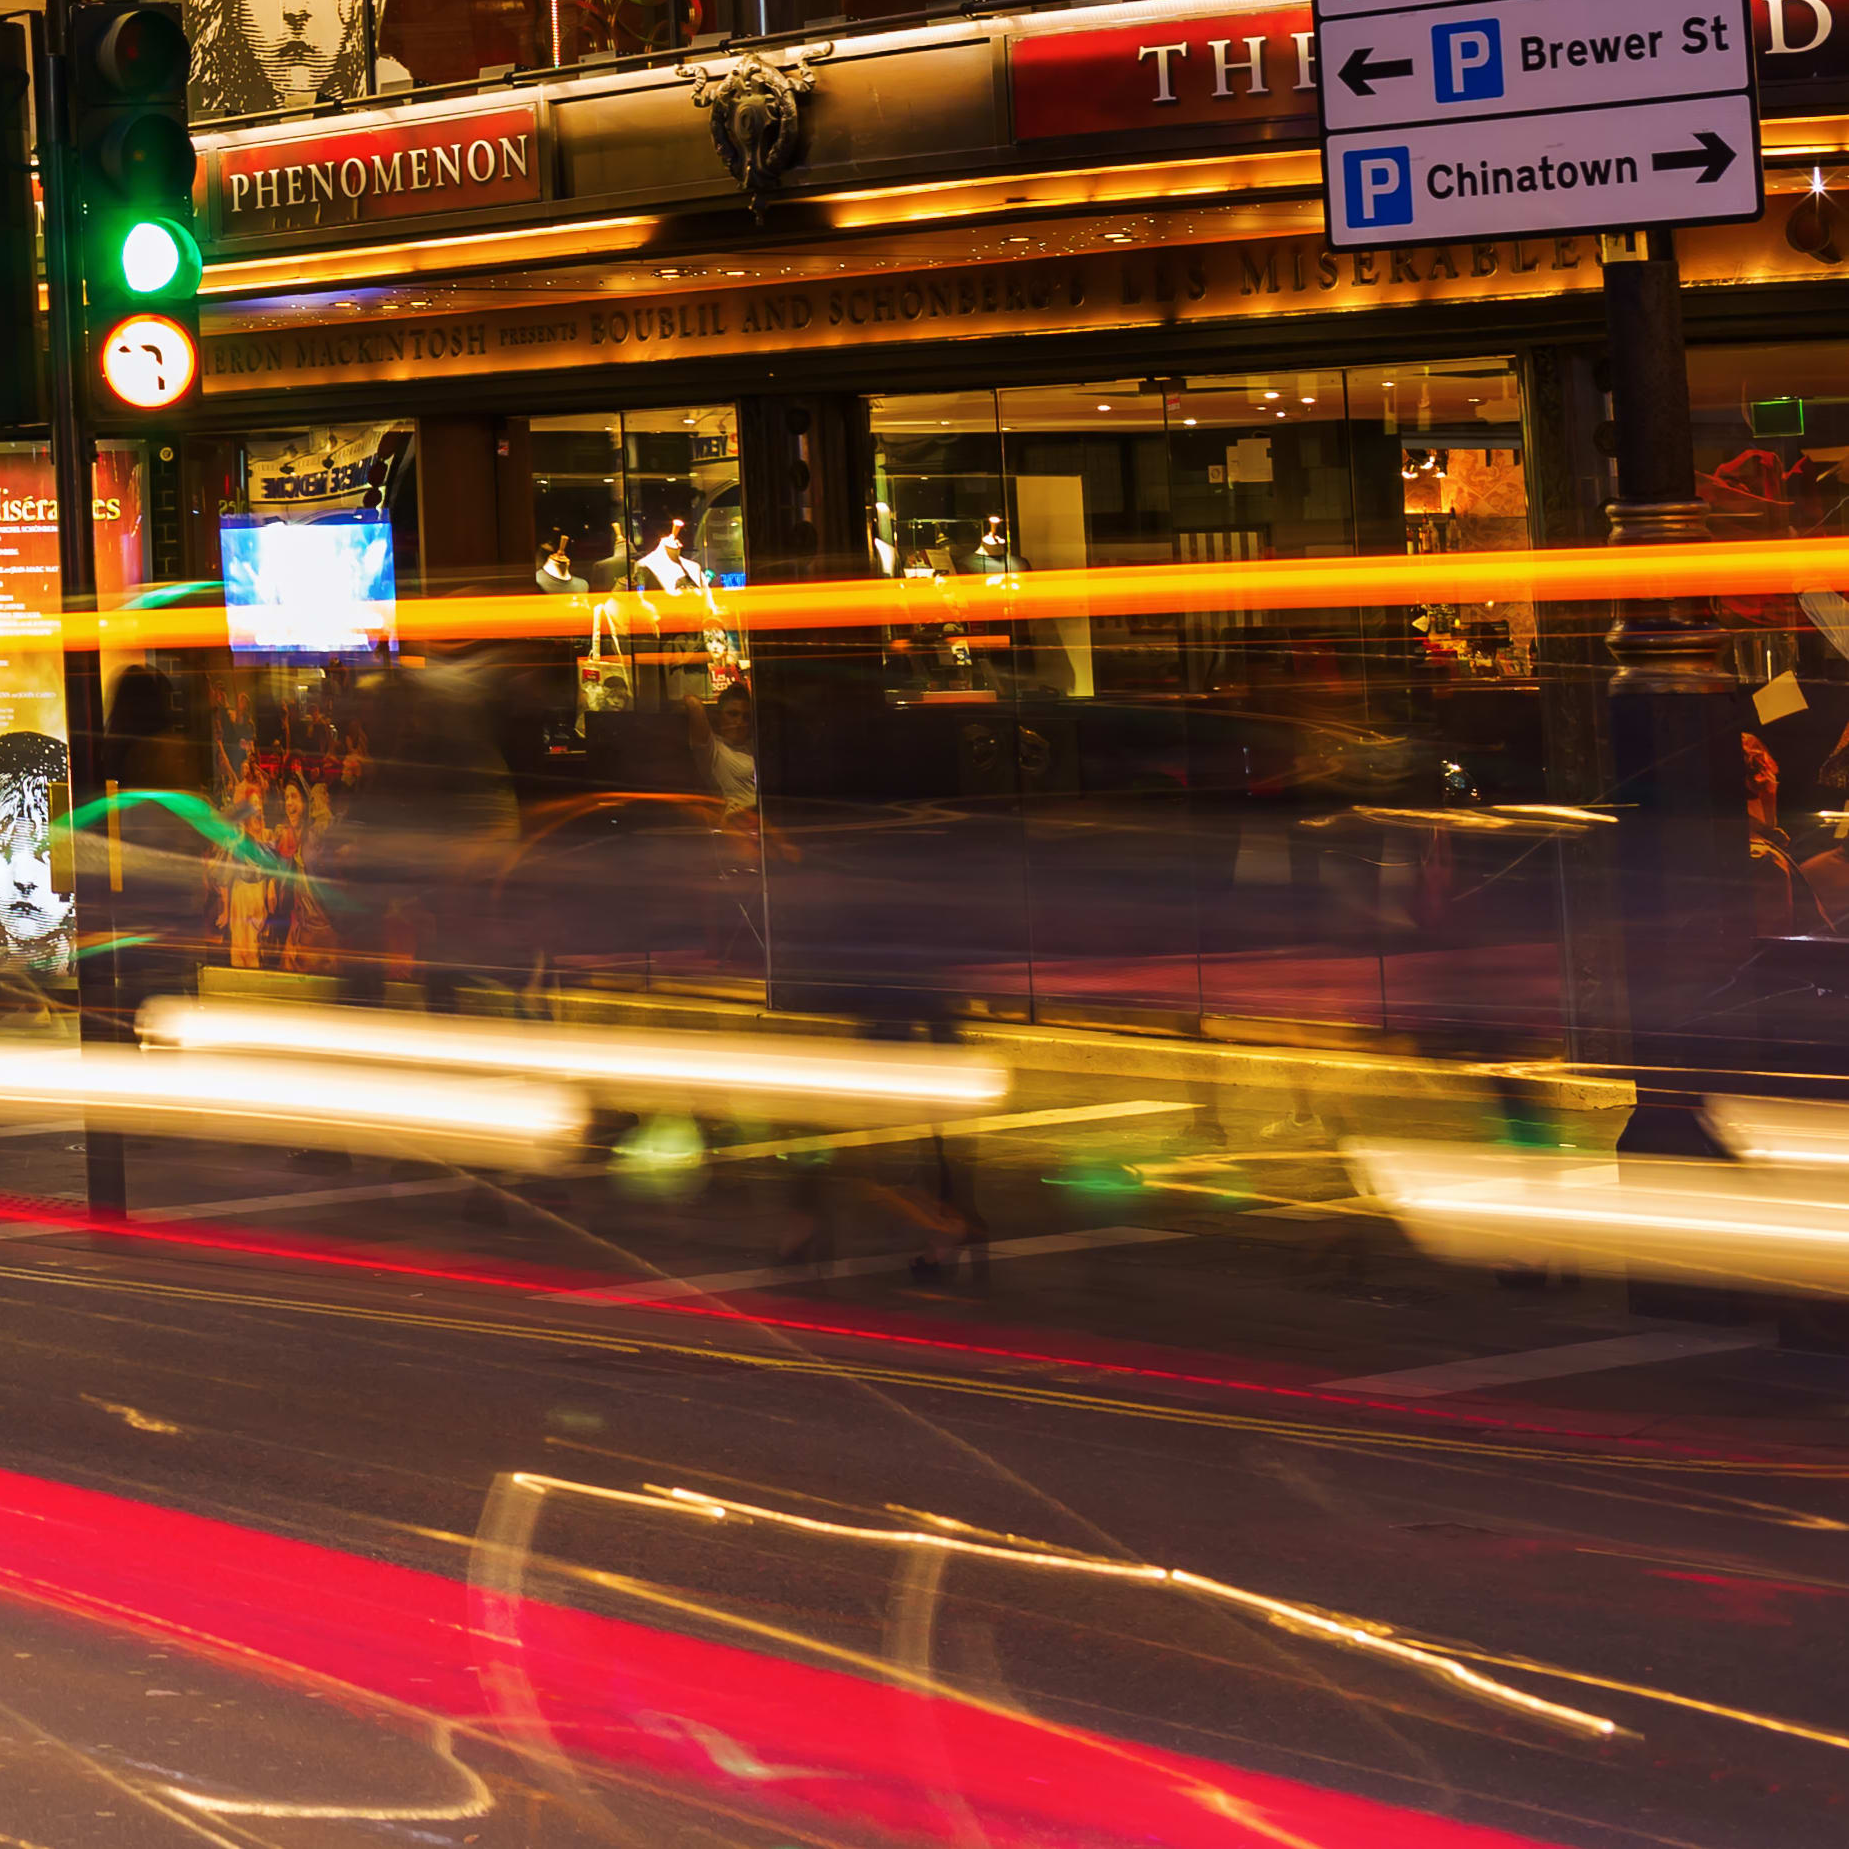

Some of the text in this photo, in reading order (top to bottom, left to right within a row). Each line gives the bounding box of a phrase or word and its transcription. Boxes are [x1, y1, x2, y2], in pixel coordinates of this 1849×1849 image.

[1521, 31, 1664, 72] Brewer
[1682, 15, 1730, 55] St
[230, 134, 529, 213] PHENOMENON
[1426, 154, 1639, 200] Chinatown
[296, 324, 487, 369] MACKINTOSH
[499, 321, 579, 347] PRESENTS
[589, 302, 728, 346] BOUBLIL
[741, 294, 813, 334] AND
[1121, 255, 1207, 305] LES
[1240, 233, 1604, 296] MISERABLE
